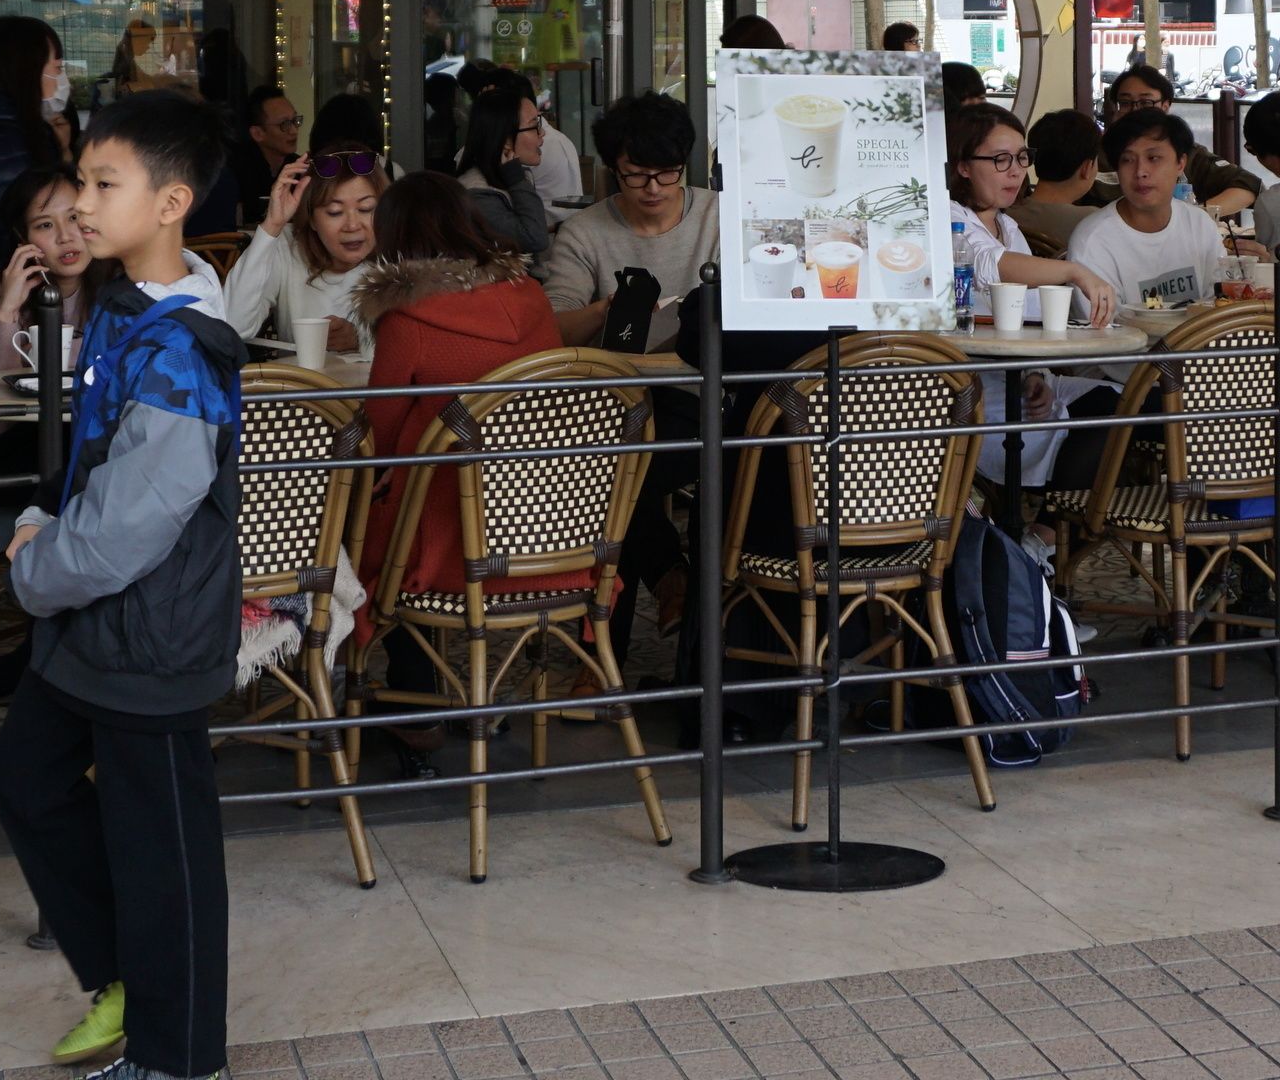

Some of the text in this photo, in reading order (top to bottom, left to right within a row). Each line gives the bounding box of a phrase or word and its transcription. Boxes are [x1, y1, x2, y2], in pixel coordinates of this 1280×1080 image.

[856, 138, 909, 150] SPECIAL
[857, 151, 910, 162] DRINKS
[1142, 275, 1194, 303] CNNECT
